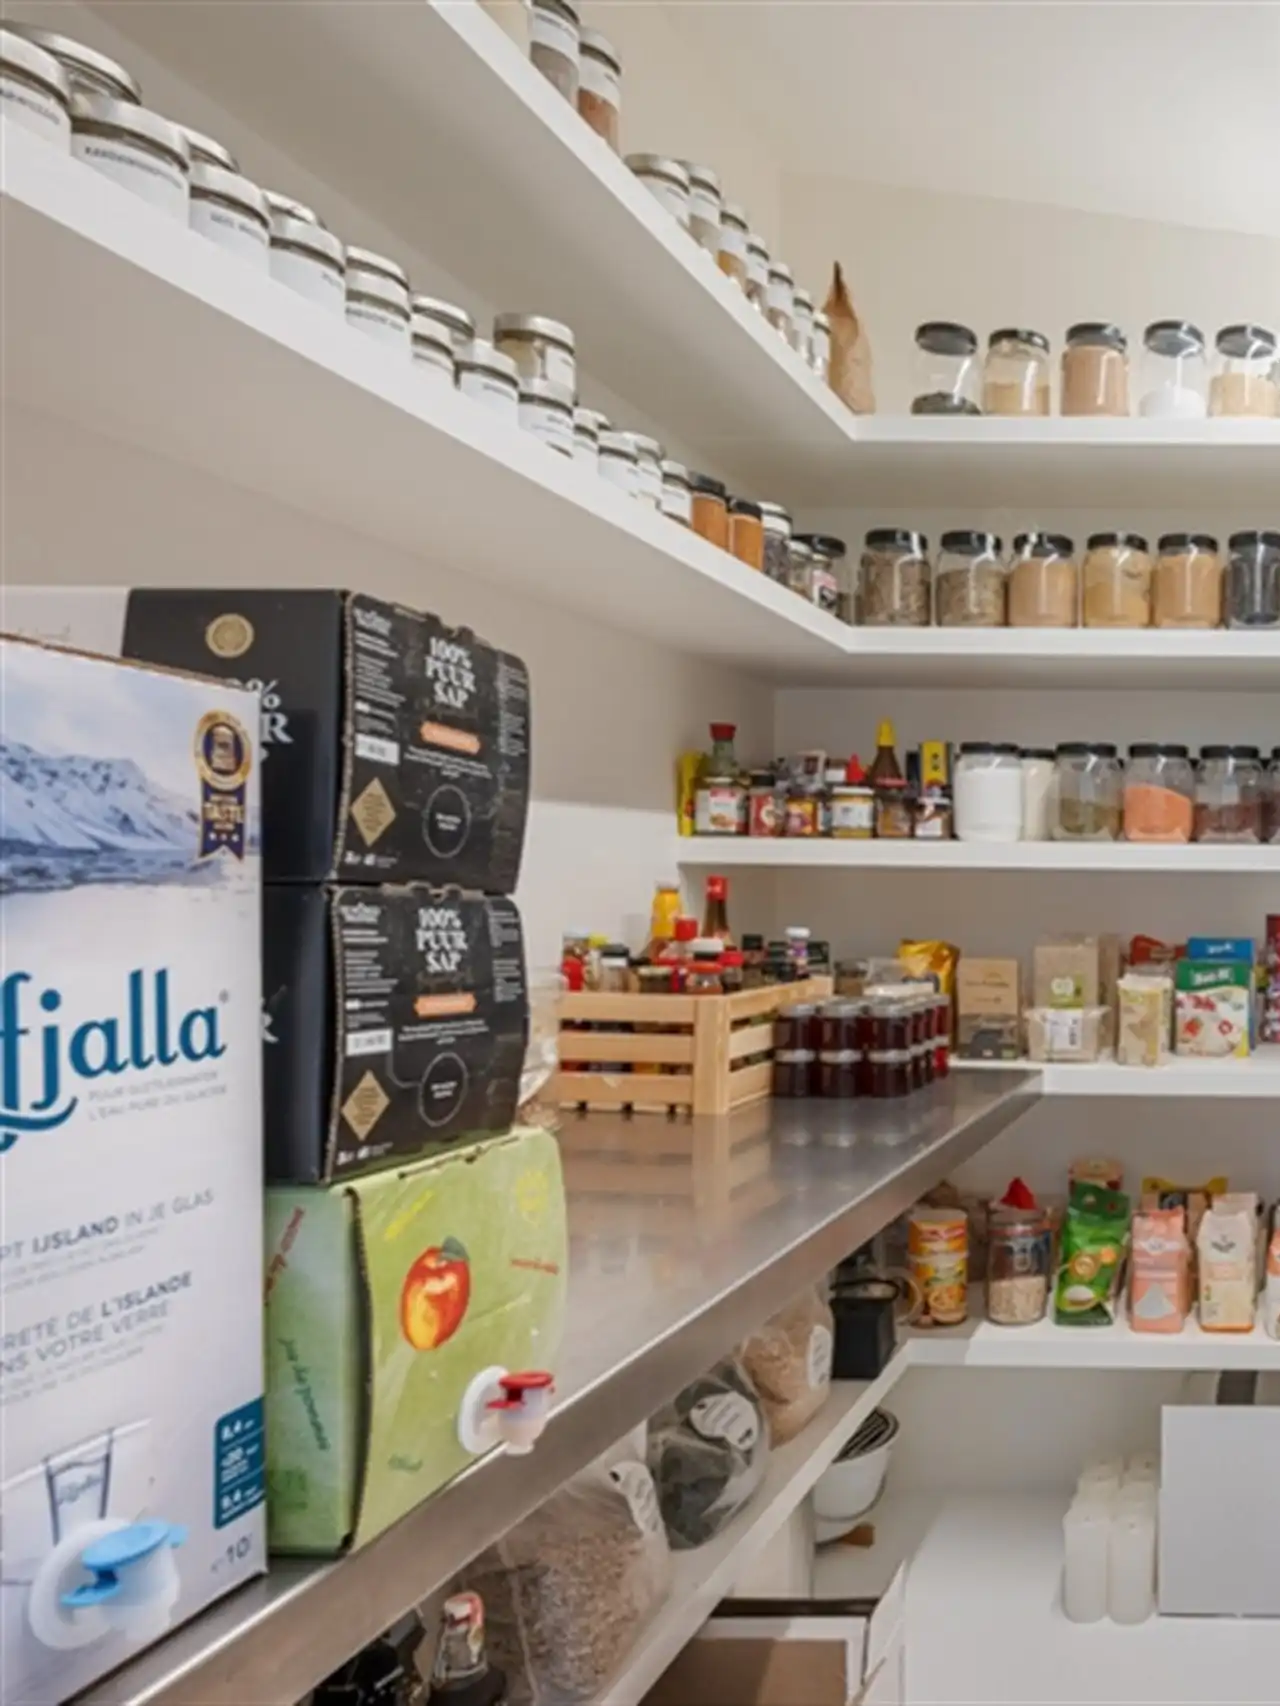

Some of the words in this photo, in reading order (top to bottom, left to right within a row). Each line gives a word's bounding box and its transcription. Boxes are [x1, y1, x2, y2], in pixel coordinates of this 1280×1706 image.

[430, 637, 472, 669] 100%
[425, 656, 476, 693] PUUR
[434, 682, 469, 708] SAP
[418, 908, 462, 929] 100%
[415, 929, 468, 951] PUUR
[425, 951, 462, 973] SAP
[31, 1215, 119, 1254] IJSLAND
[124, 1209, 143, 1227] IN
[172, 1188, 215, 1214] GLAS
[66, 1305, 93, 1330] DE
[101, 1270, 193, 1318] L'ISLANDE
[36, 1325, 104, 1362] VOTRE
[112, 1300, 169, 1334] VERRE
